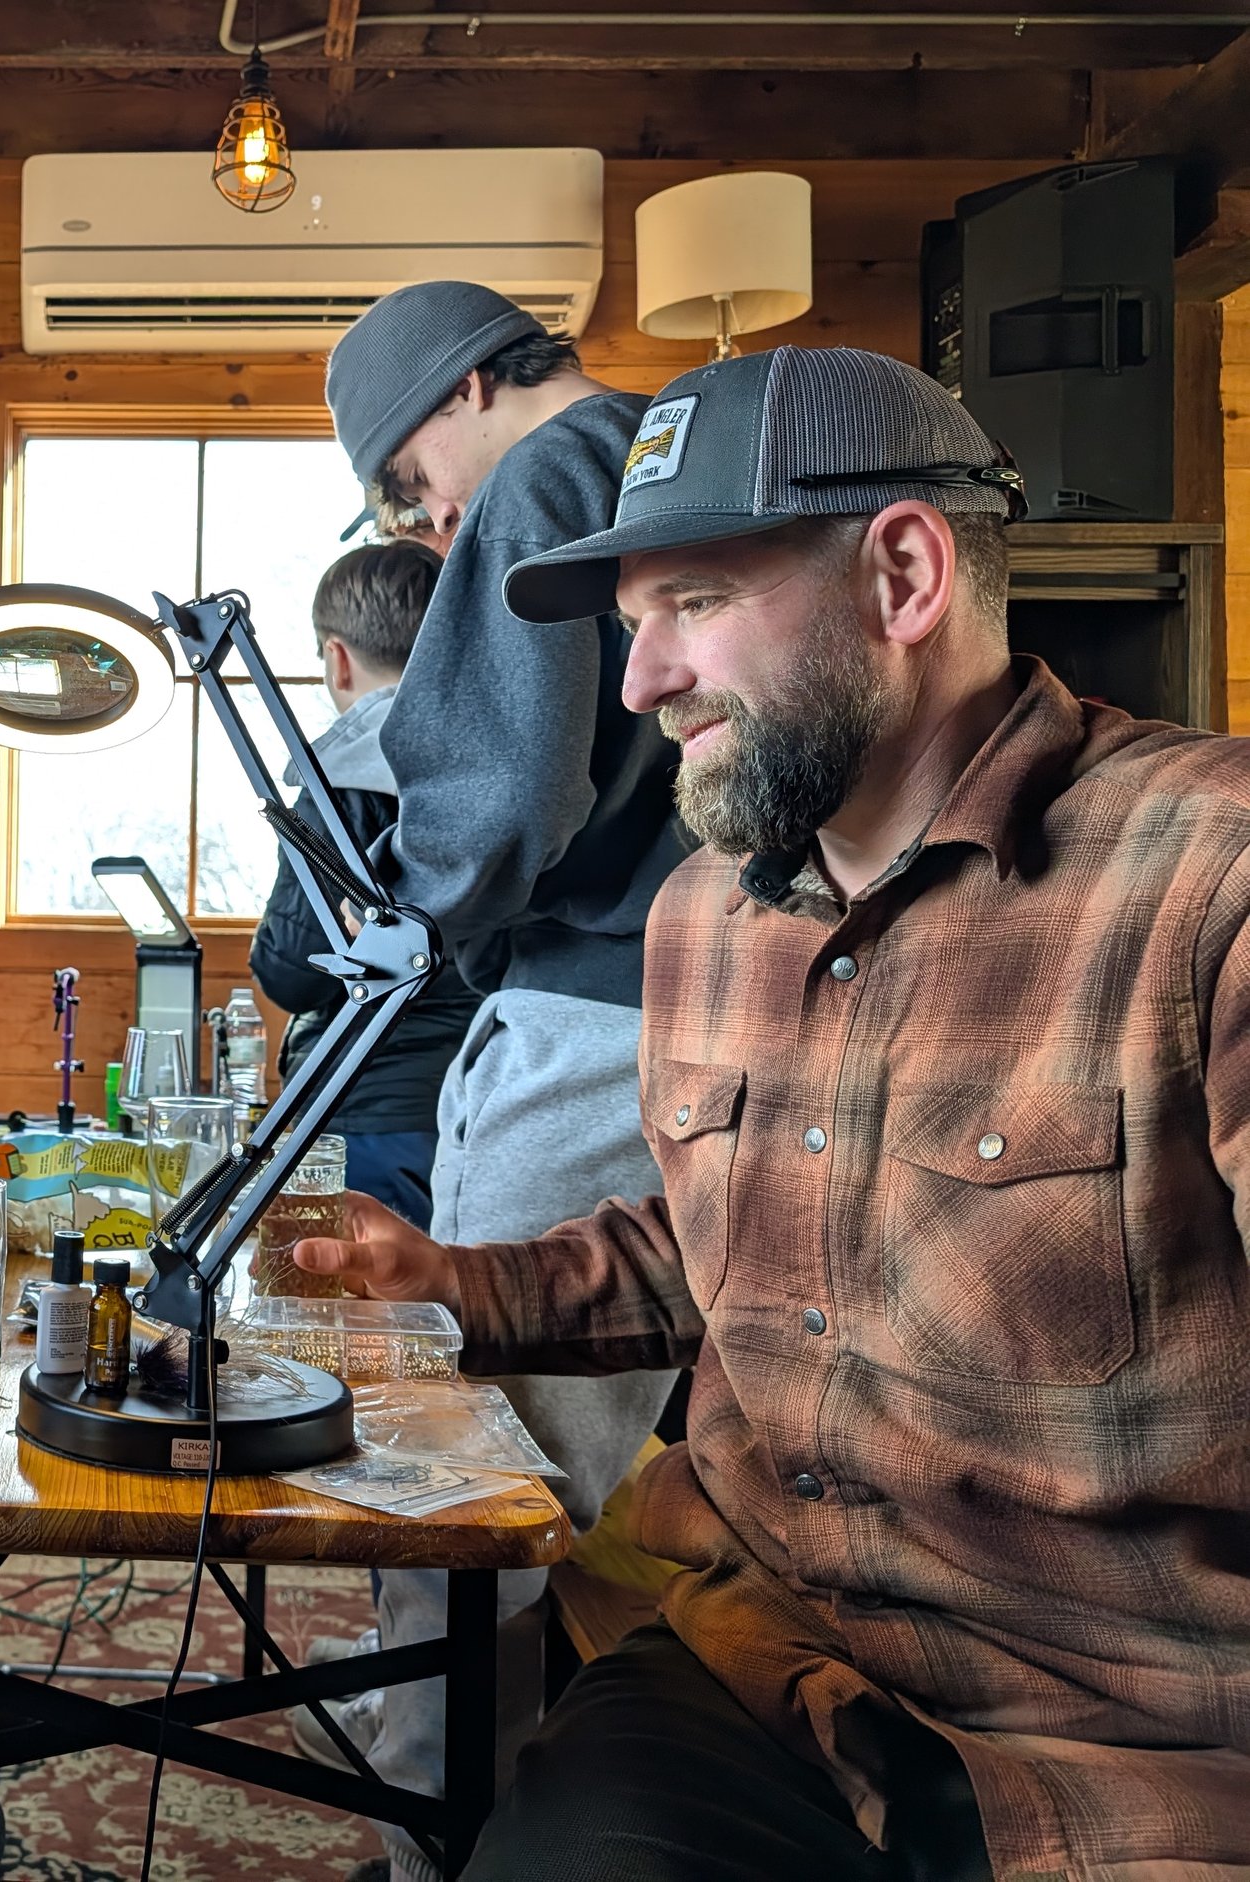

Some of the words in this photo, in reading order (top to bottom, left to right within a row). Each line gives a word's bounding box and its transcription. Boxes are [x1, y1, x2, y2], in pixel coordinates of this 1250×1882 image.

[650, 408, 688, 426] ANGLER
[640, 465, 661, 481] YORK
[178, 1442, 211, 1450] KIRKA
